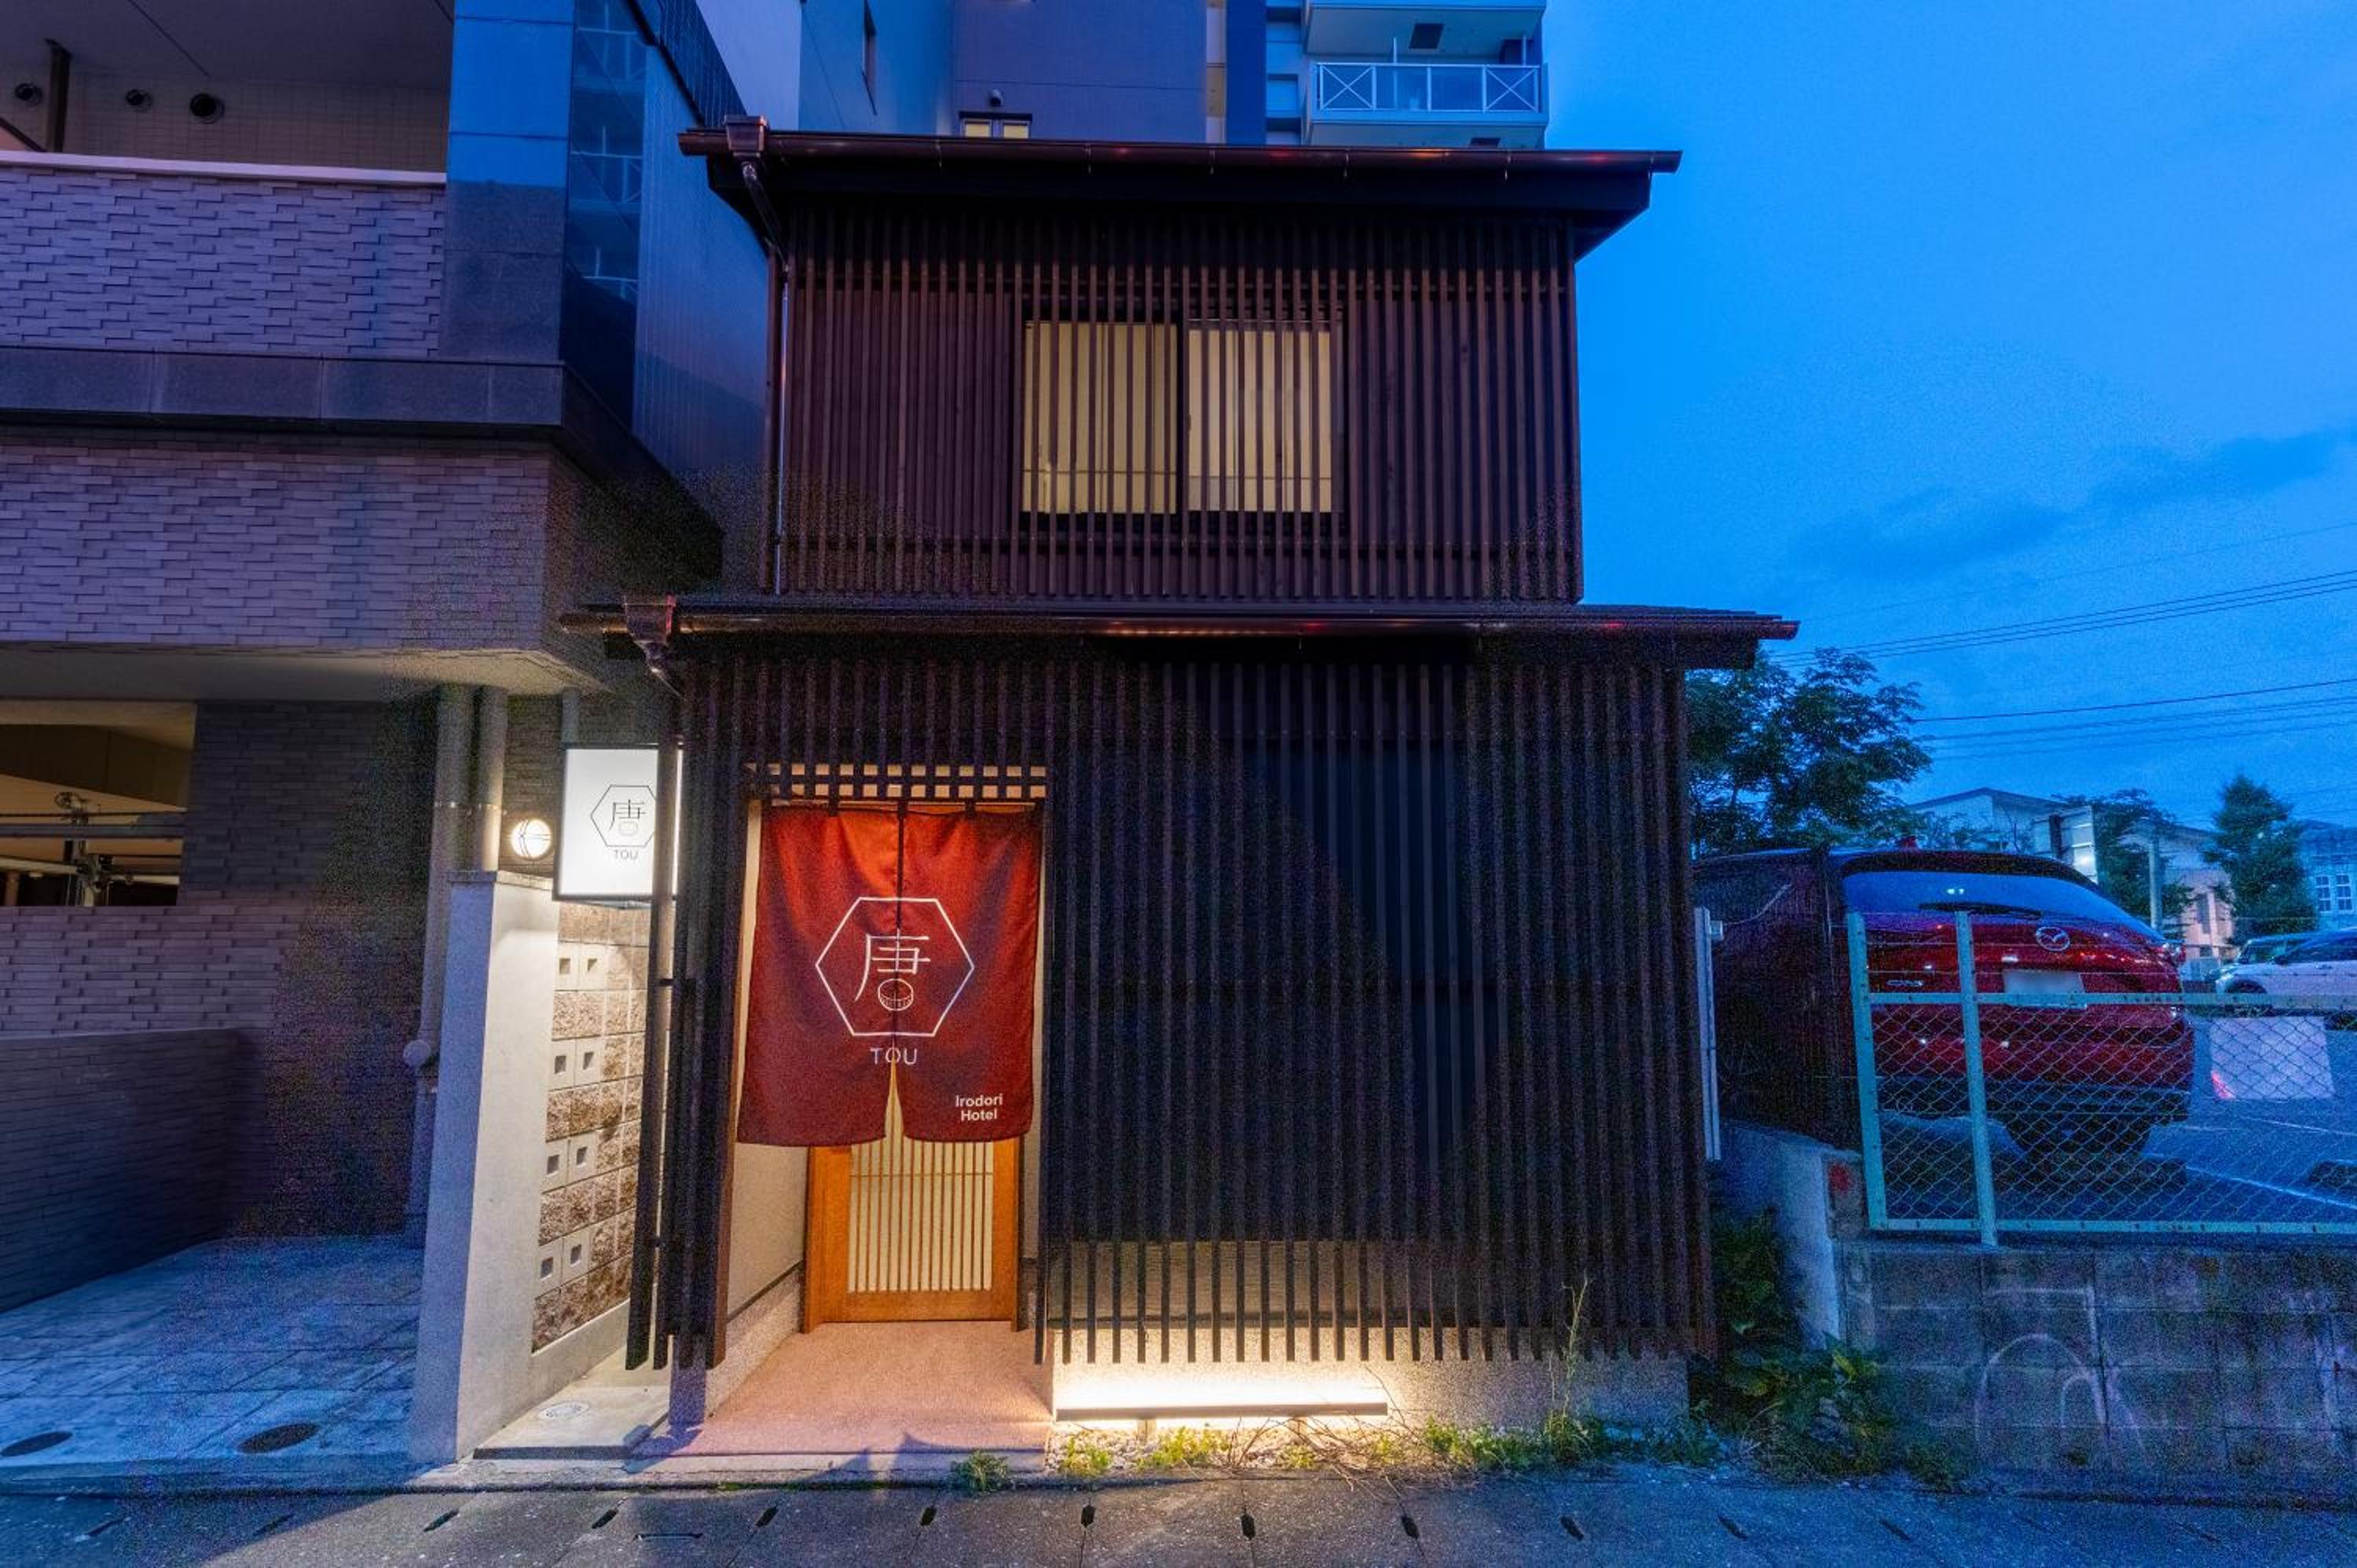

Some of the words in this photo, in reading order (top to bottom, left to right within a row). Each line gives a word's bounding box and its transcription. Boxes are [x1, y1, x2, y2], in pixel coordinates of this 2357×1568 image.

[613, 848, 639, 860] TOU
[870, 1047, 918, 1065] TOU
[955, 1093, 1003, 1107] Irodori
[961, 1108, 997, 1121] Hotel
